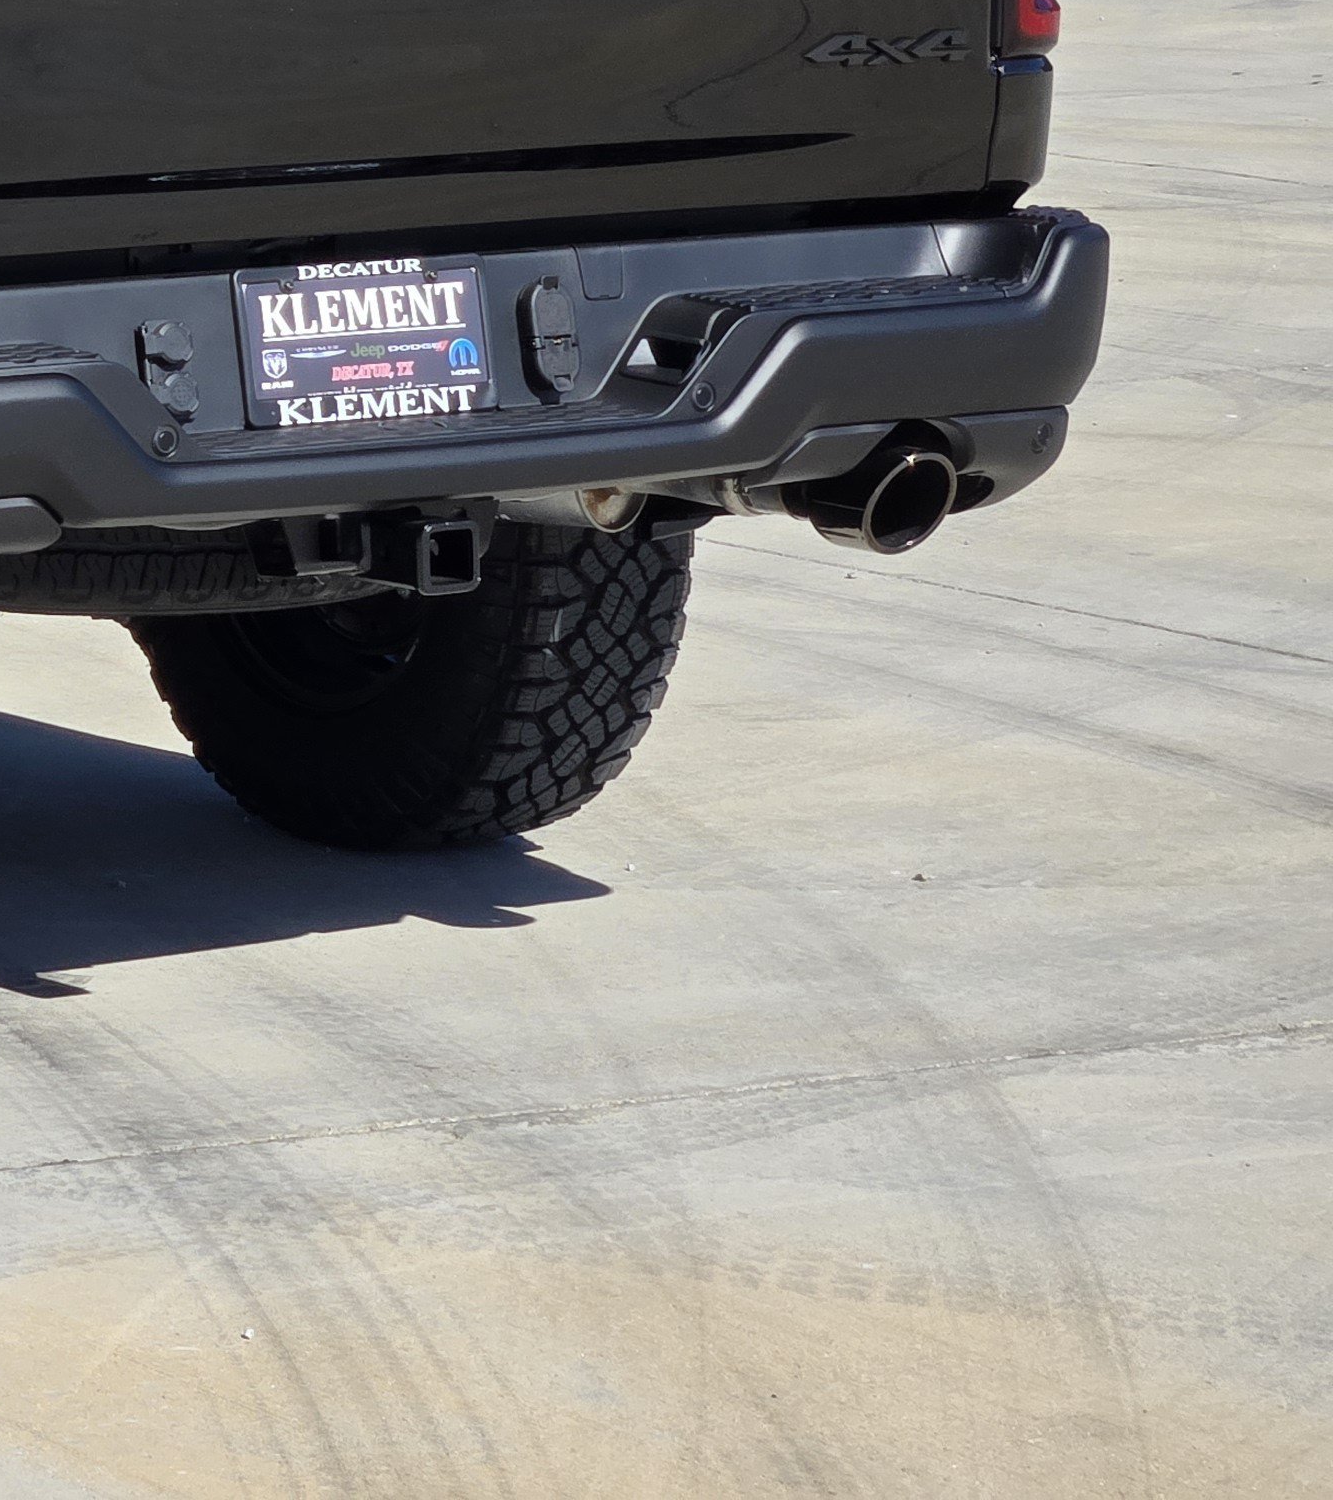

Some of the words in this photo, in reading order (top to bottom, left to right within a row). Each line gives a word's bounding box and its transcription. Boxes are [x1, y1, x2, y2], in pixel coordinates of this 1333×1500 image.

[297, 258, 423, 281] DECATUR
[258, 282, 464, 337] KLEMENT
[351, 343, 386, 359] Jeep
[332, 362, 394, 381] DECATUR,
[396, 361, 414, 376] TX
[277, 385, 476, 426] KLEMENT
